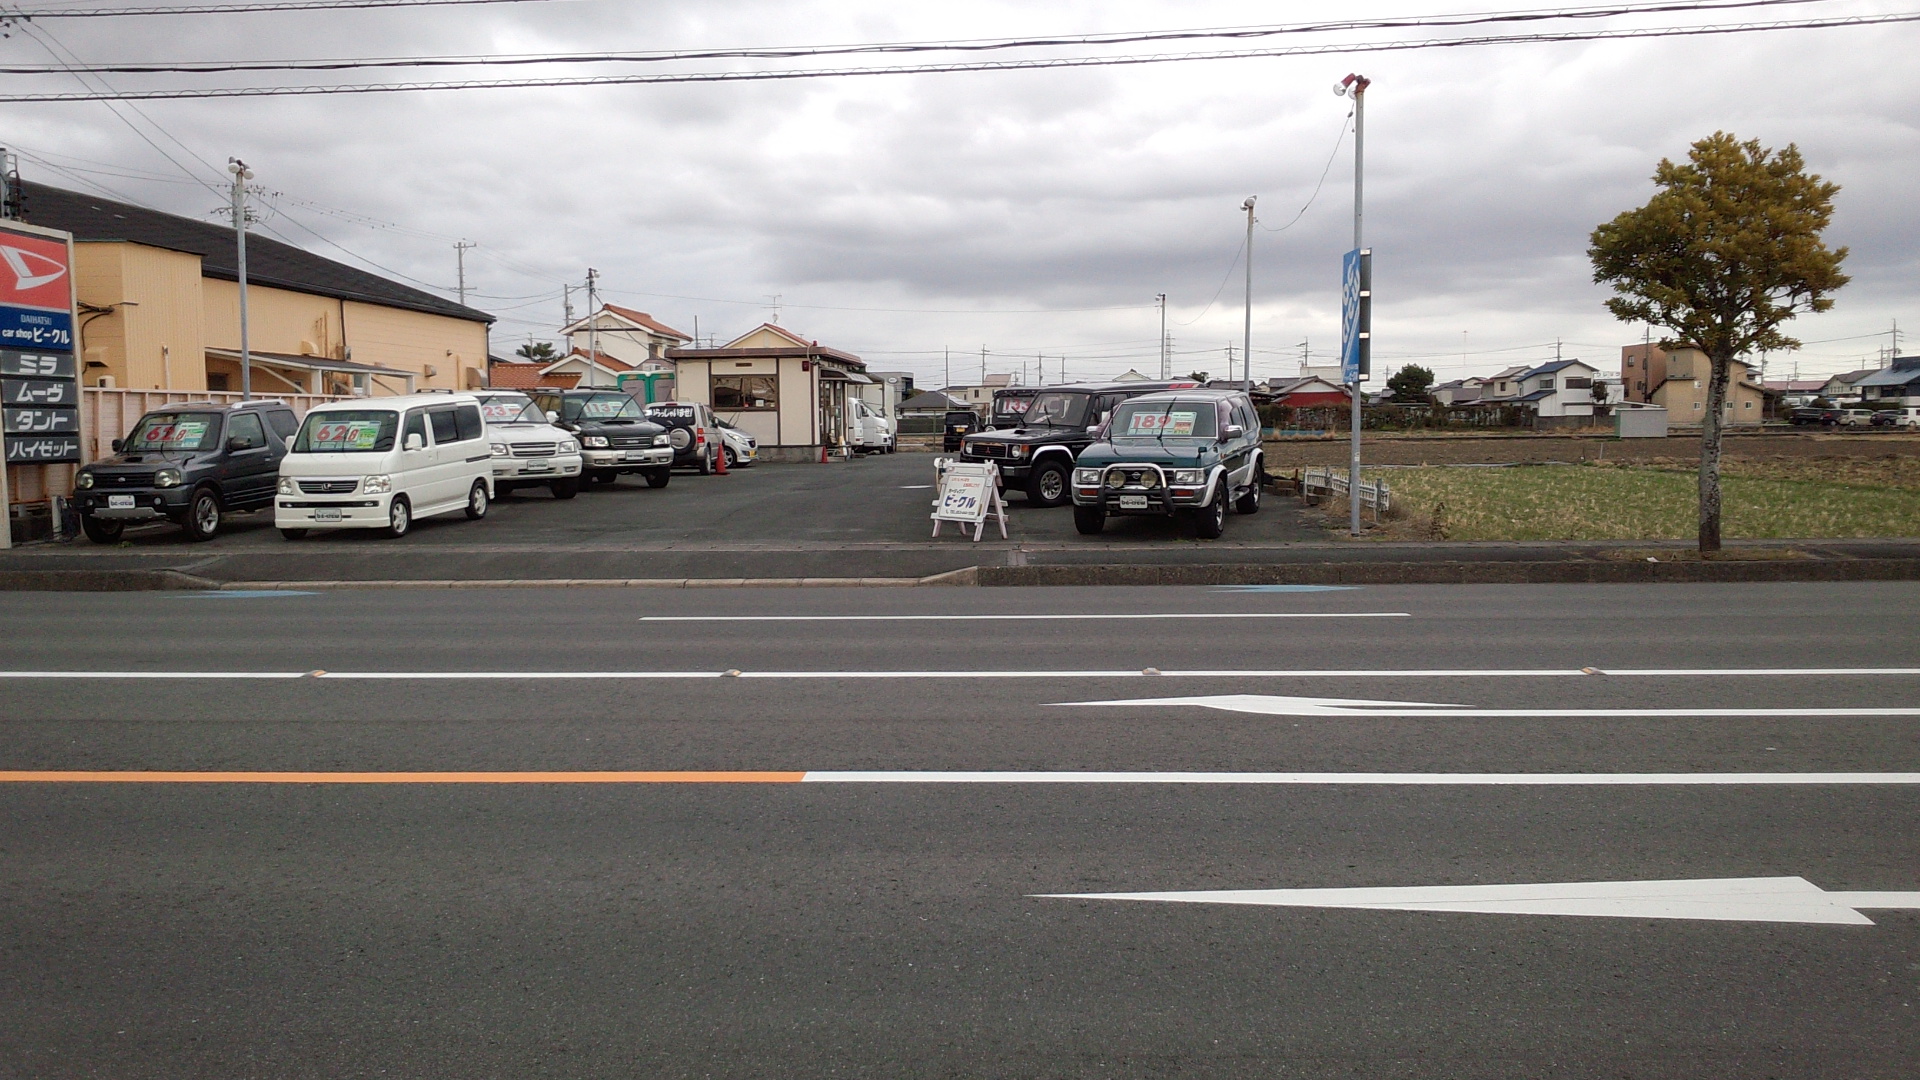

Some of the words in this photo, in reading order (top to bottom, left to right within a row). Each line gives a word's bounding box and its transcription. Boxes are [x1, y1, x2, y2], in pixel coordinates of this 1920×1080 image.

[21, 314, 52, 325] DAIHATSU
[2, 329, 14, 338] car
[19, 354, 57, 375] ミラ
[16, 382, 64, 403] ムーヴ
[16, 411, 68, 430] タント
[1133, 415, 1172, 428] 189
[316, 425, 360, 442] 628
[9, 441, 78, 458] ハイゼット
[944, 494, 977, 508] ビークル
